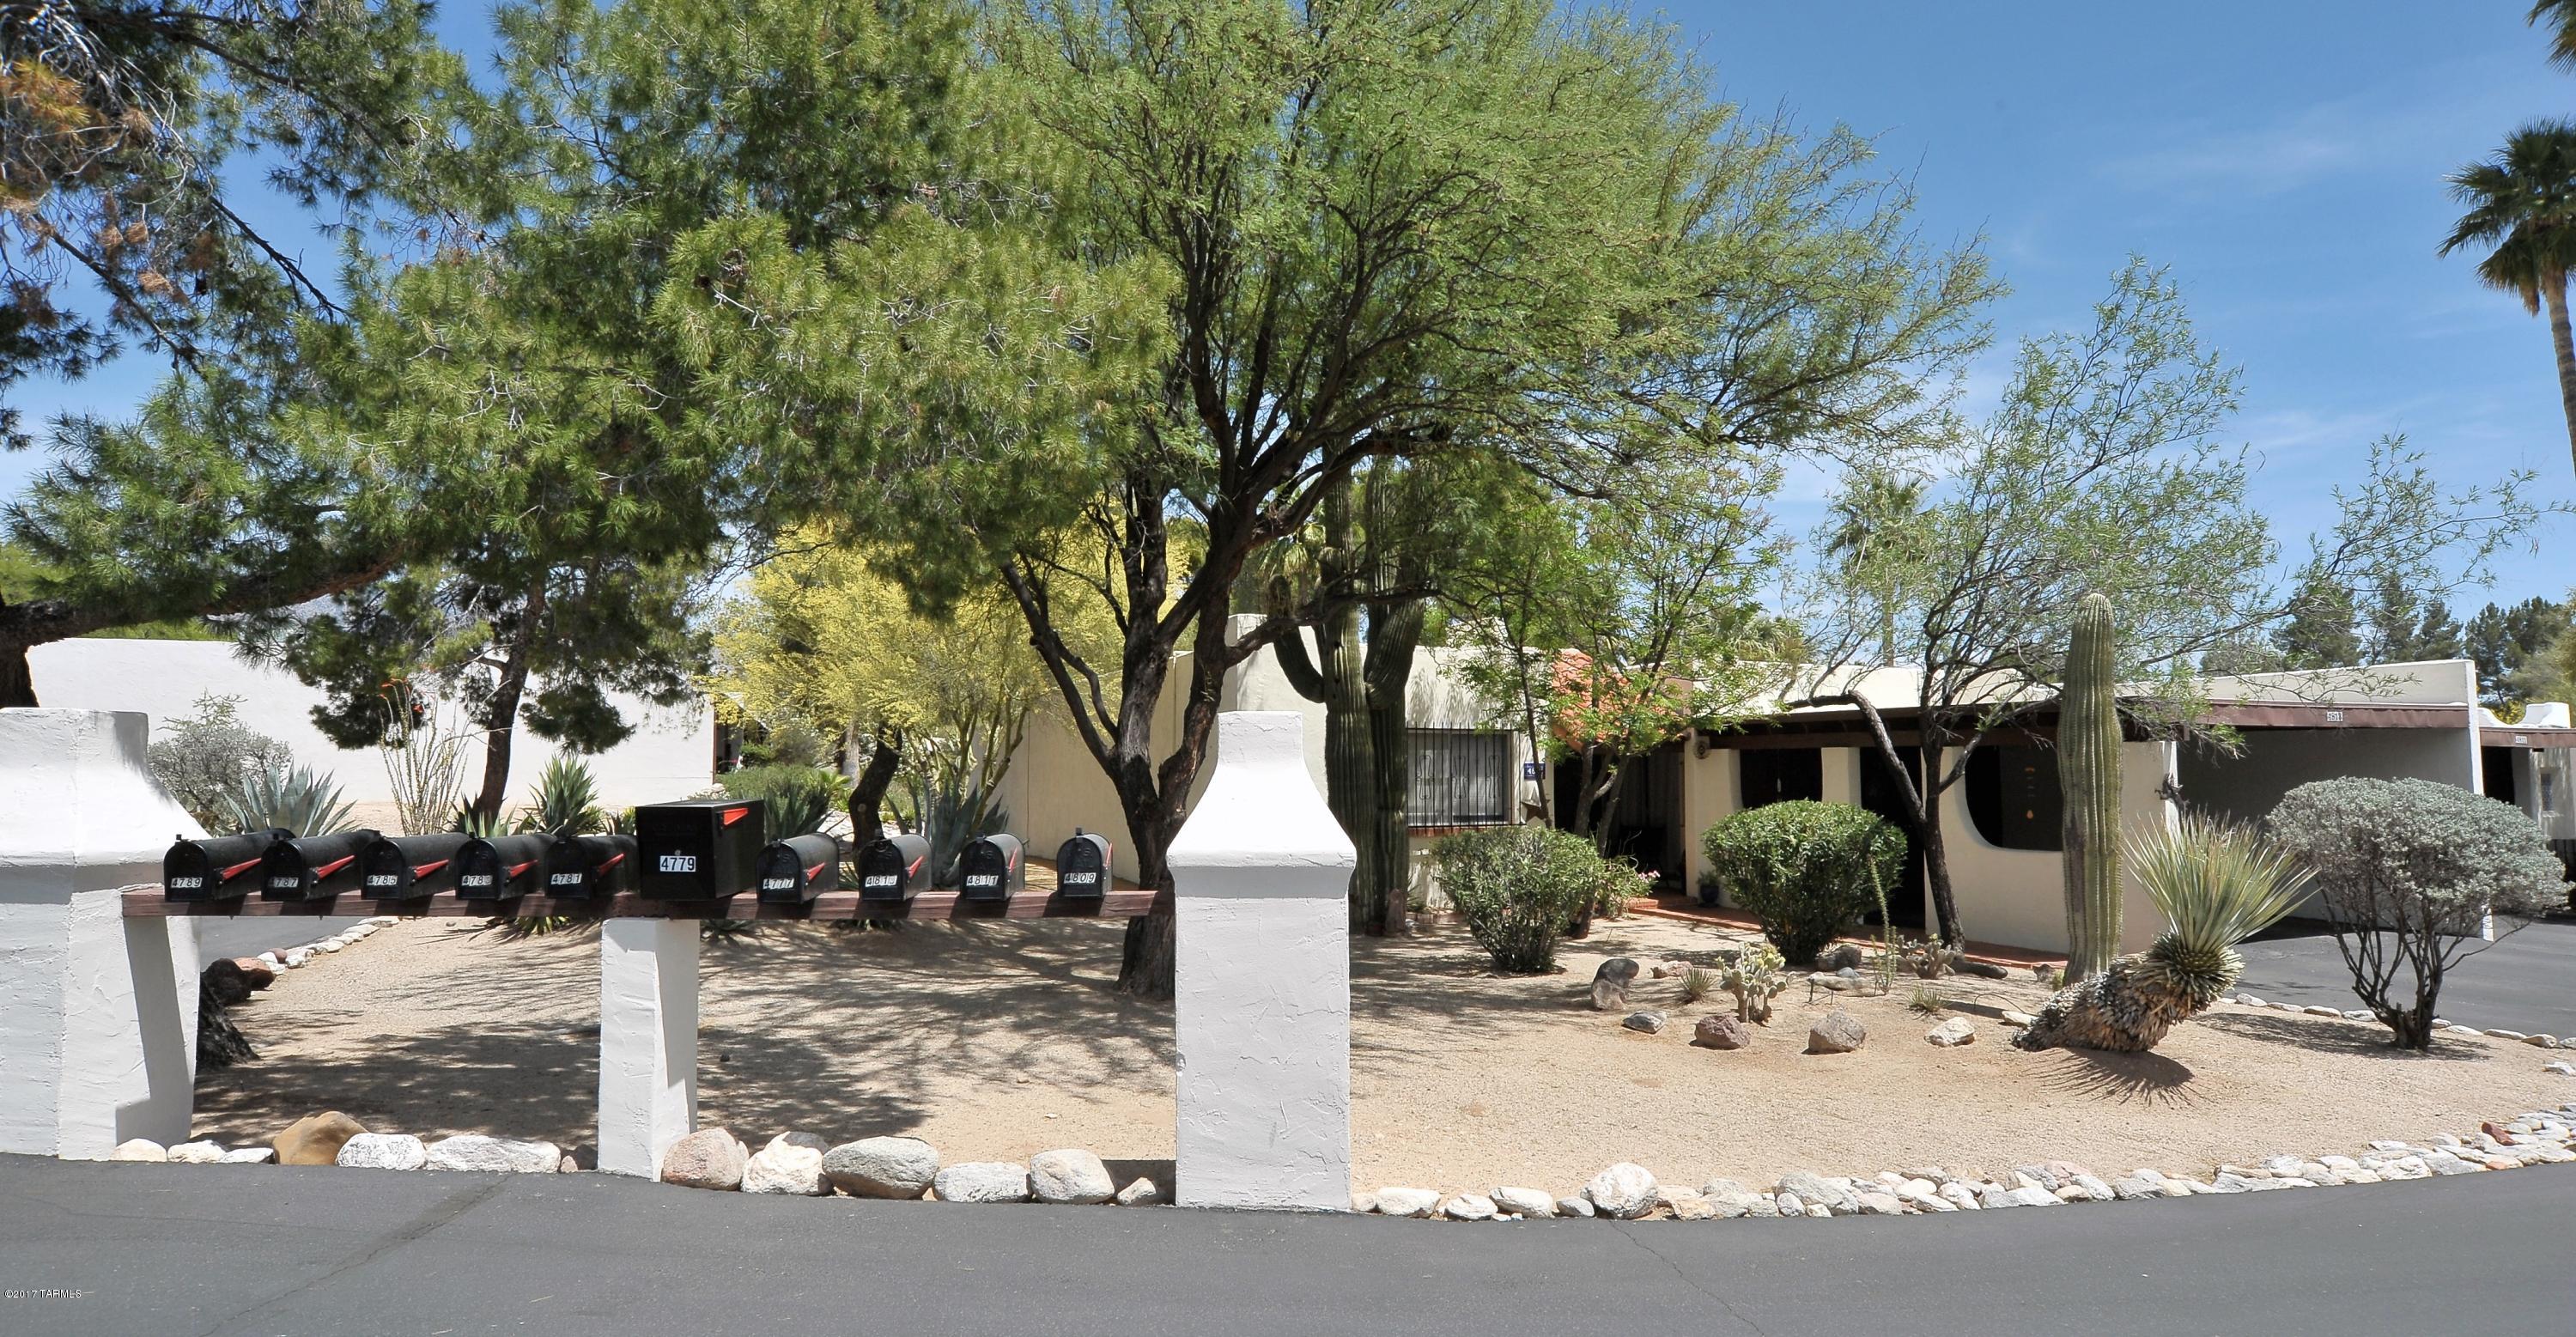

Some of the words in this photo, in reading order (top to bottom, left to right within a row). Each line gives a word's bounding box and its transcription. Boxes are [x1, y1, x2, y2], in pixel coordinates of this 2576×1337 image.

[661, 857, 695, 871] 4779
[172, 878, 202, 887] 4789
[552, 874, 581, 884] 4781
[967, 876, 998, 885] 4811
[1065, 873, 1096, 883] 4809
[763, 878, 794, 889] 4777
